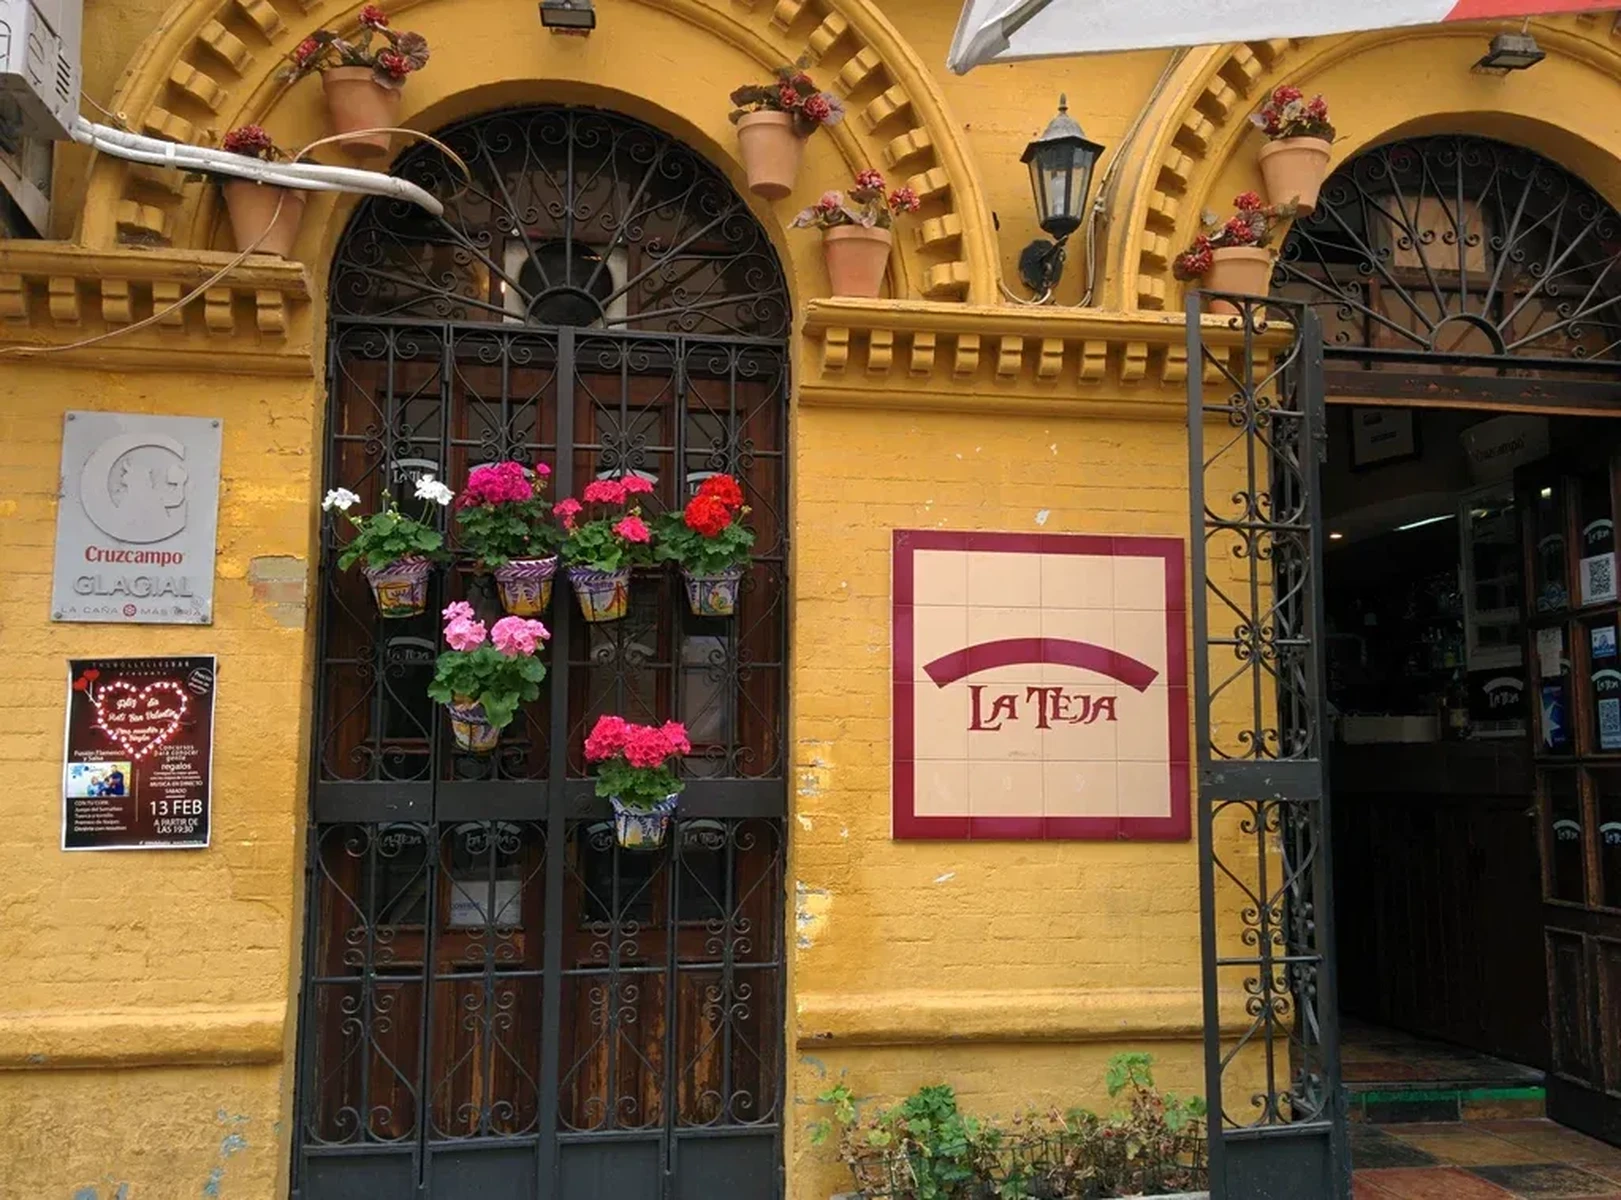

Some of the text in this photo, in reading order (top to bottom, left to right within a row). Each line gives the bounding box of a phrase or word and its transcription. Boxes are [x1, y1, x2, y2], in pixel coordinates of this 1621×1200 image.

[85, 545, 183, 567] Cruzcampo
[73, 576, 193, 599] GLACIAL
[83, 605, 118, 614] CAÑA
[967, 685, 1118, 731] LA TEJA
[161, 762, 192, 772] regalos
[149, 799, 203, 816] 13 FEB
